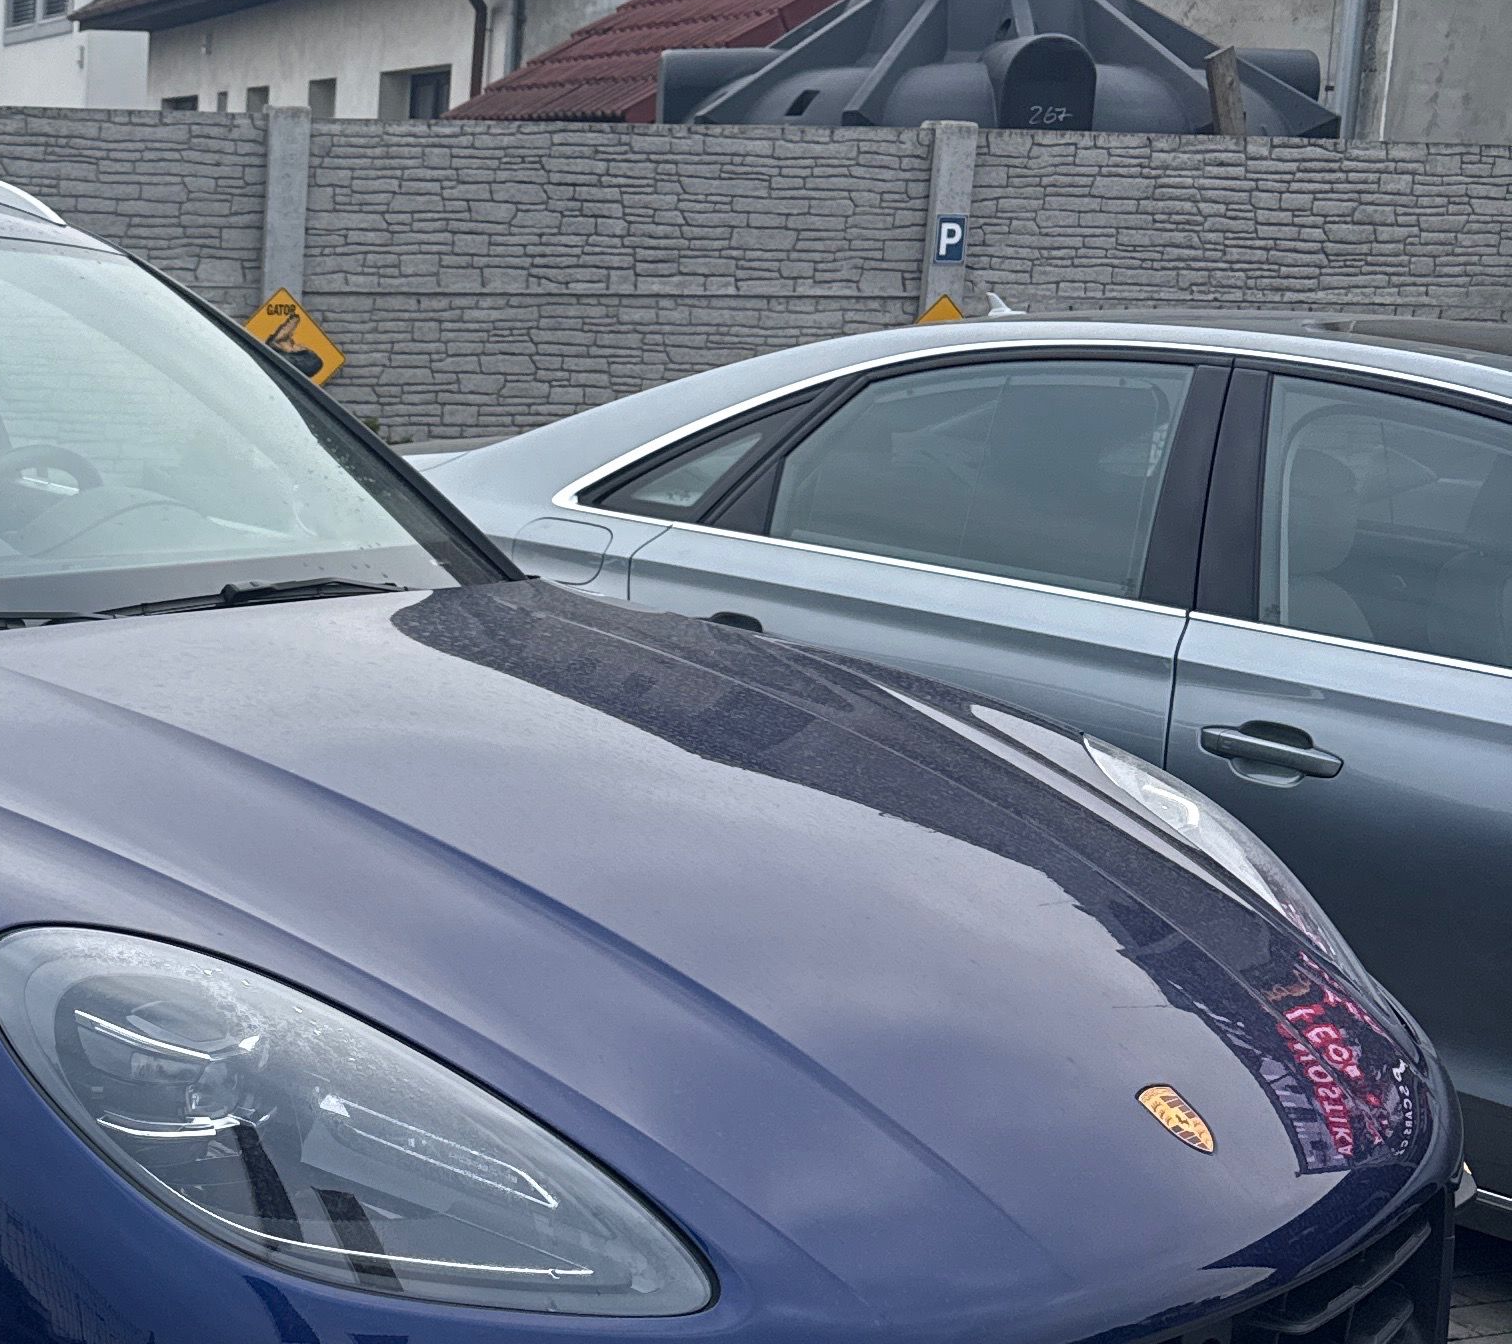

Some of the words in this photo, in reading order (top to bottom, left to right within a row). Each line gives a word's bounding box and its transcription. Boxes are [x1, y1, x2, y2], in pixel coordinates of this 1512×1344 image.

[1029, 106, 1072, 125] 267
[938, 222, 962, 256] P
[266, 304, 296, 316] GATOR
